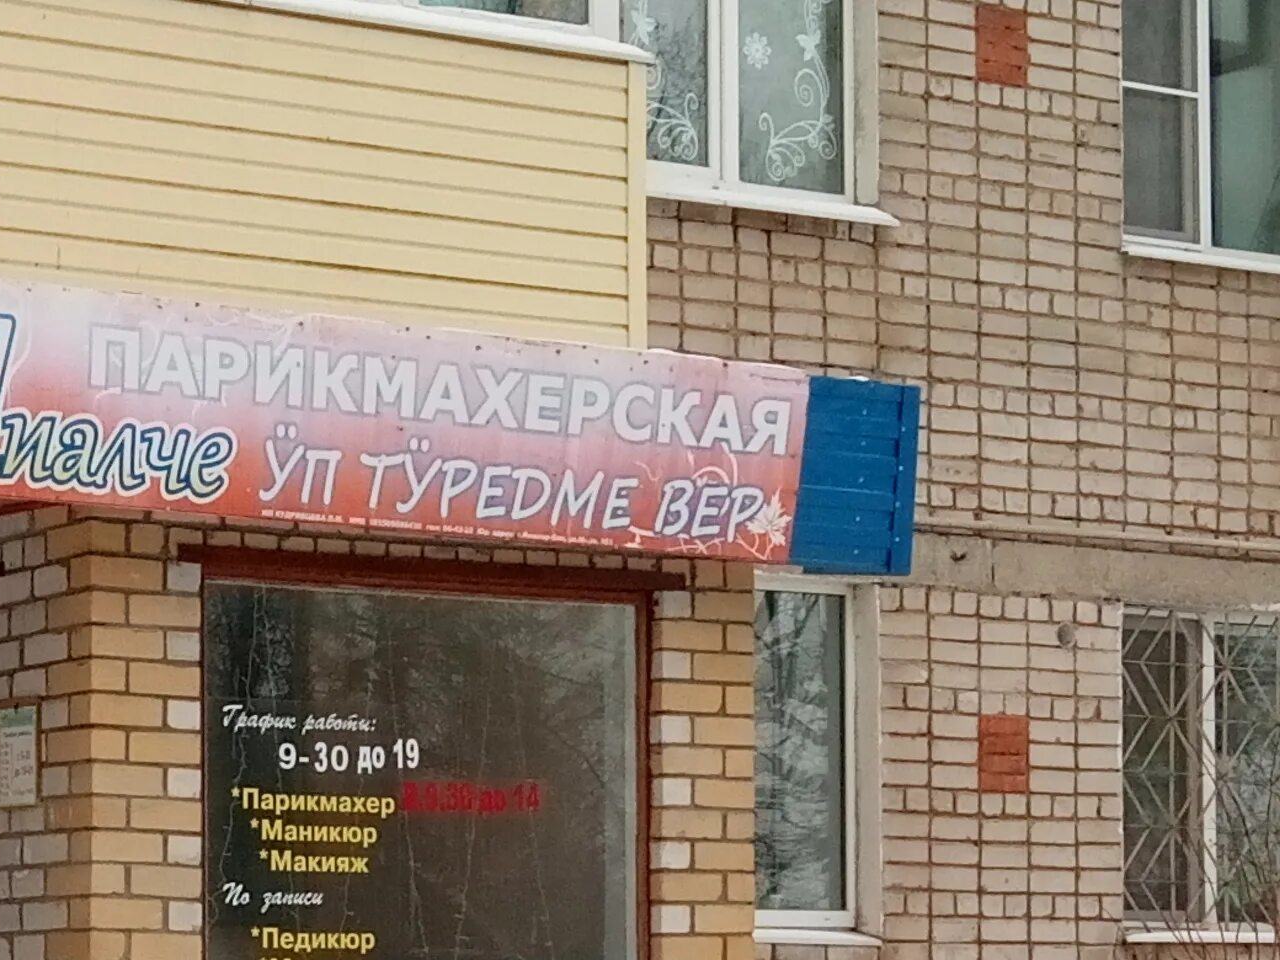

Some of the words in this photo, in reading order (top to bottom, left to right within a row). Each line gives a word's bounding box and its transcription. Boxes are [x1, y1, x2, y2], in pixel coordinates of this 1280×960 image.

[89, 323, 793, 457] ПАРИКМАХЕРСКАЯ
[654, 479, 764, 543] ВЕР
[222, 704, 296, 734] График
[302, 712, 377, 733] работы:
[278, 742, 349, 772] 9-30
[357, 745, 386, 774] до
[393, 738, 420, 769] 19
[222, 882, 250, 906] По
[261, 891, 324, 913] записи
